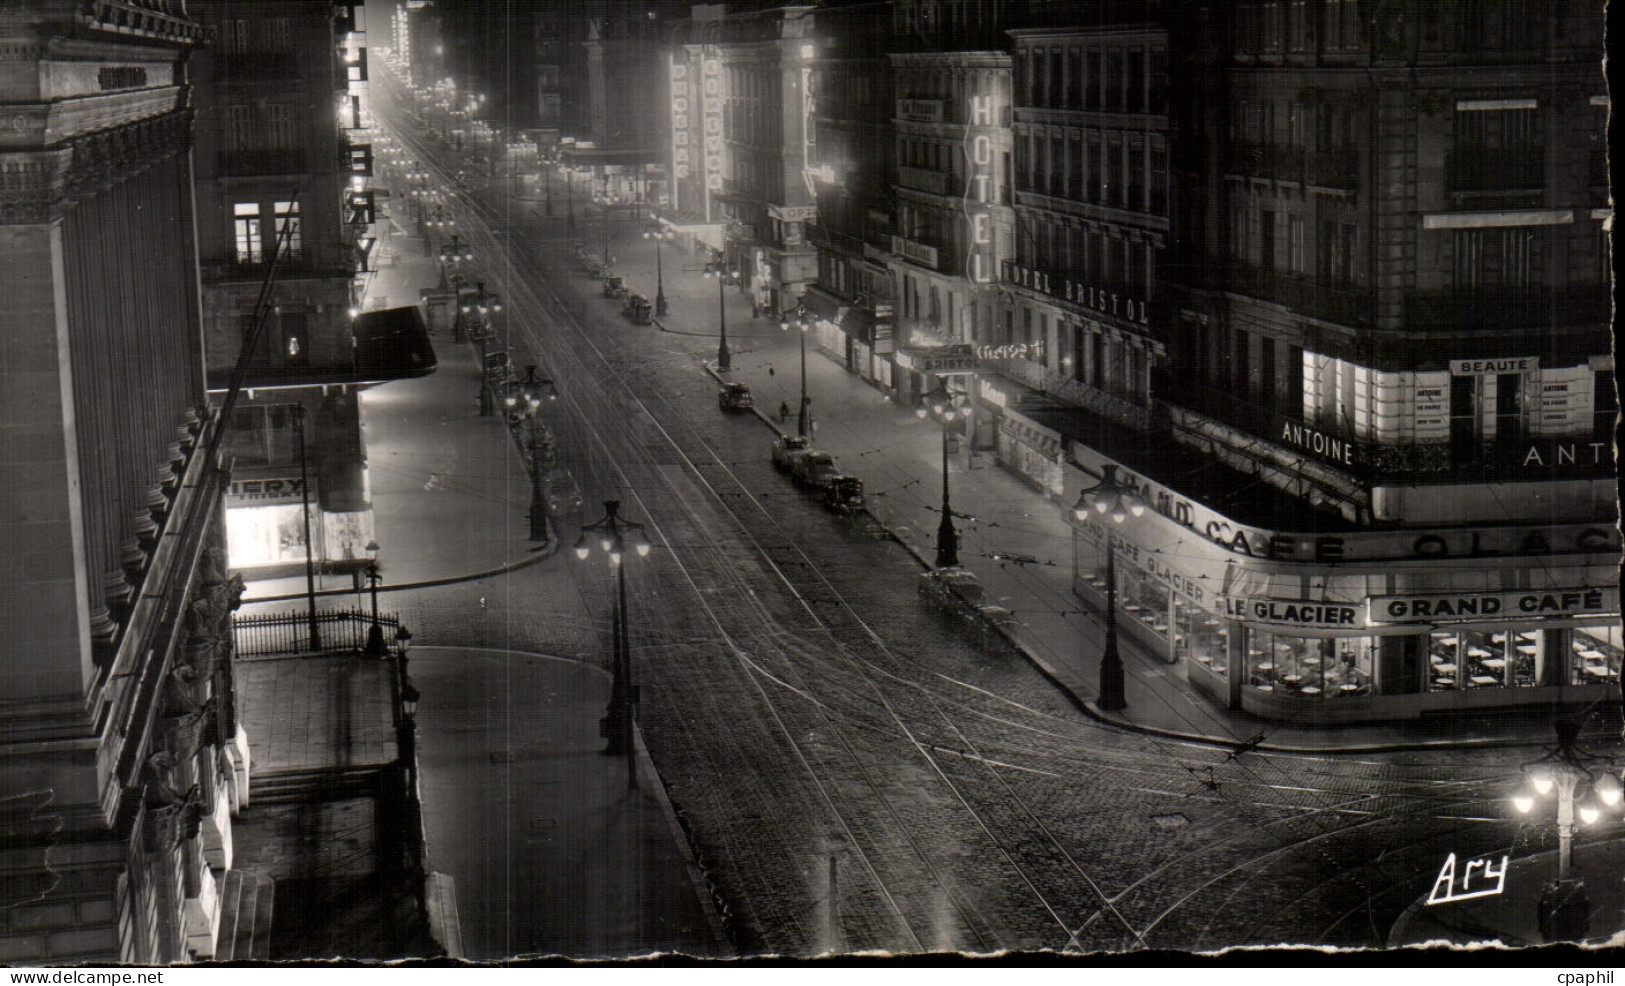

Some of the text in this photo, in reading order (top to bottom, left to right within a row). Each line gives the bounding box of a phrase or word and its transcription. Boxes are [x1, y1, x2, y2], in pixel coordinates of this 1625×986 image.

[972, 95, 991, 283] HOTEL
[1065, 280, 1148, 325] BRISTOL
[925, 358, 981, 370] BRISTOL
[1282, 421, 1352, 465] ANTOINE
[1146, 555, 1204, 600] GLACIER
[1226, 597, 1356, 624] LE GLACIER
[1387, 590, 1603, 617] GRAND CAFÉ
